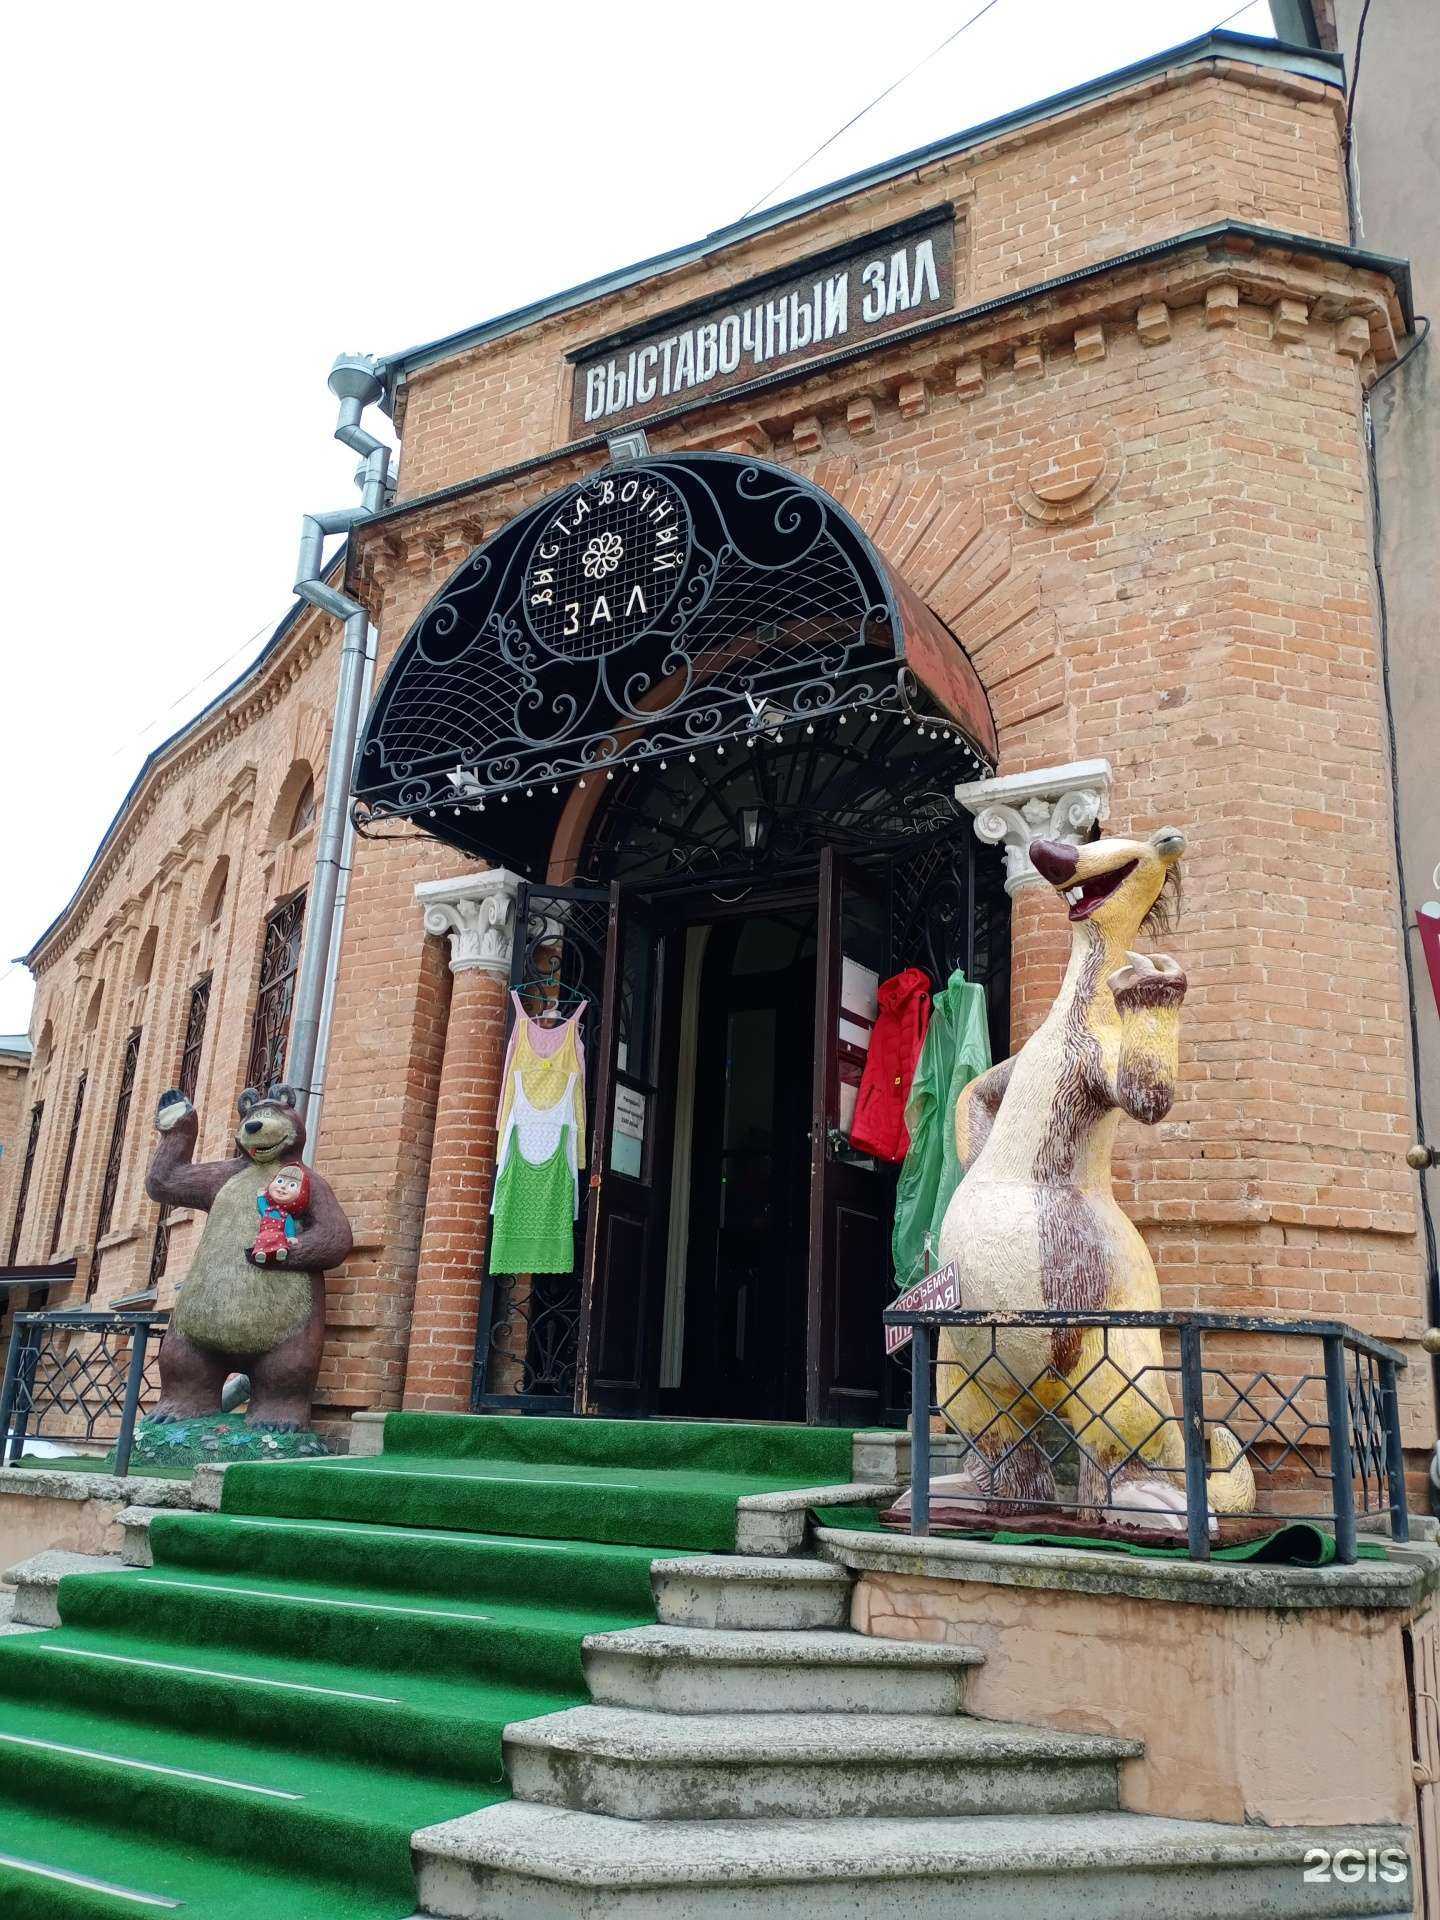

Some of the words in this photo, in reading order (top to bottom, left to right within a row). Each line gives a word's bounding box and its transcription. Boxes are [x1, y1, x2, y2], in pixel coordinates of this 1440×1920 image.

[584, 271, 849, 423] ВЫСТАВОЧНЫЙ
[861, 239, 941, 323] ЗАЛ
[530, 480, 684, 606] ВЫСТАВОЧНЫЙ
[563, 585, 647, 636] ЗАЛ
[889, 1285, 955, 1347] ПЛНАЯ
[893, 1265, 954, 1311] ОТОСЪЕМКА
